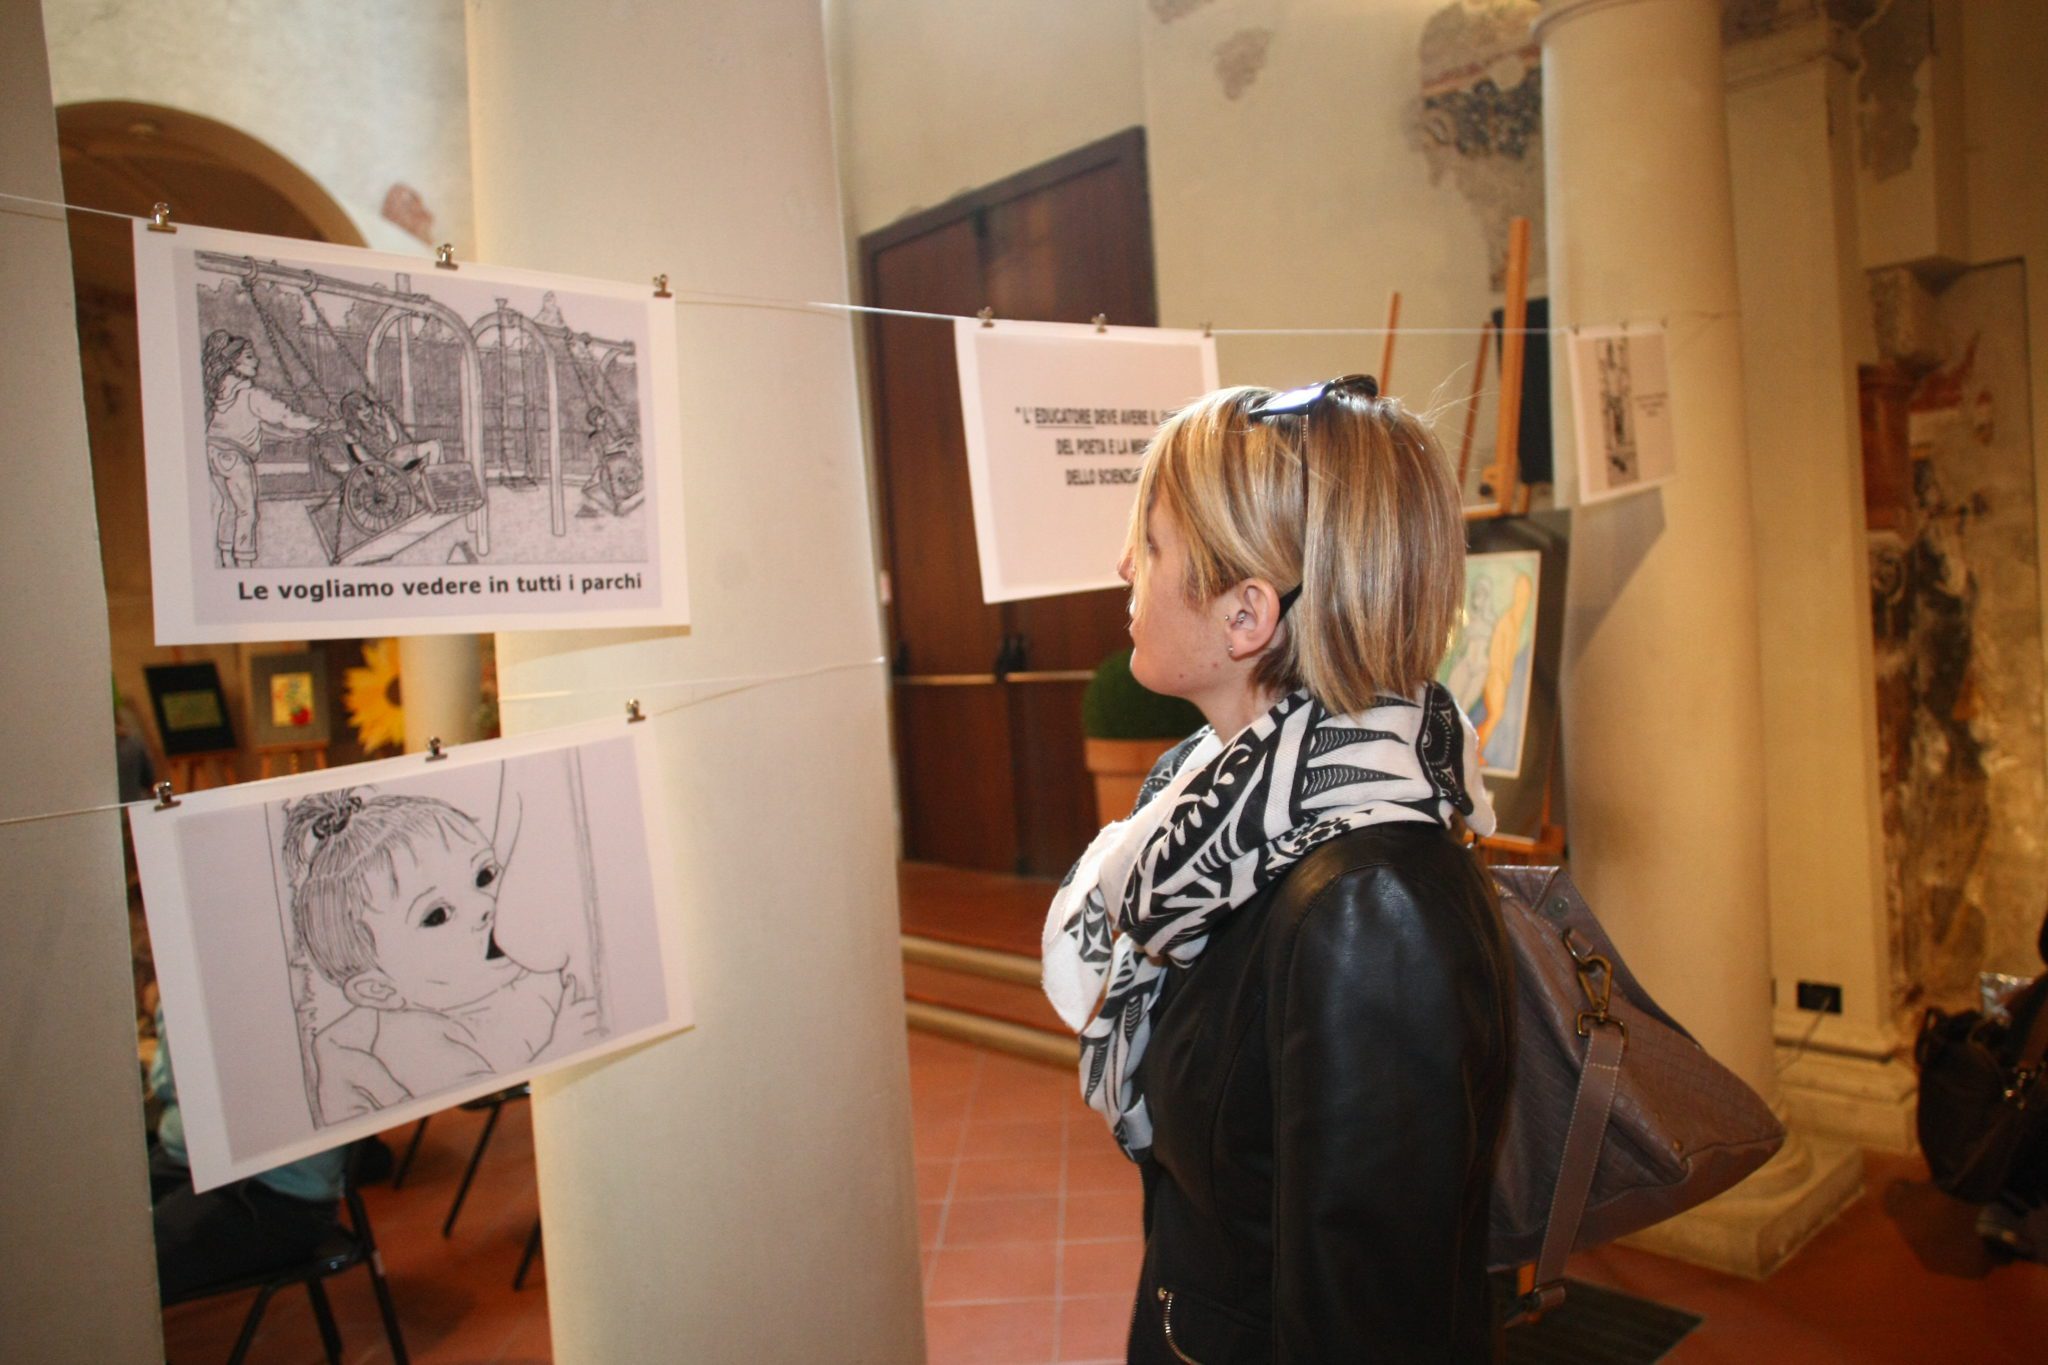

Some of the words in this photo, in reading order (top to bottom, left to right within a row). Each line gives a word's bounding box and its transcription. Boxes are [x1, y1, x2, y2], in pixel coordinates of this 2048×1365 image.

[1094, 409, 1117, 425] DEVE
[1121, 410, 1148, 425] AVERE
[1056, 438, 1074, 455] DEL
[1077, 438, 1106, 455] POETA
[1118, 439, 1127, 455] LA
[1066, 469, 1095, 485] DELLO
[238, 581, 268, 600] Le
[278, 579, 394, 602] vogliamo
[402, 577, 482, 597] vedere
[489, 576, 509, 593] in
[516, 574, 562, 592] tutti
[569, 574, 574, 591] i
[582, 573, 642, 594] parchi
